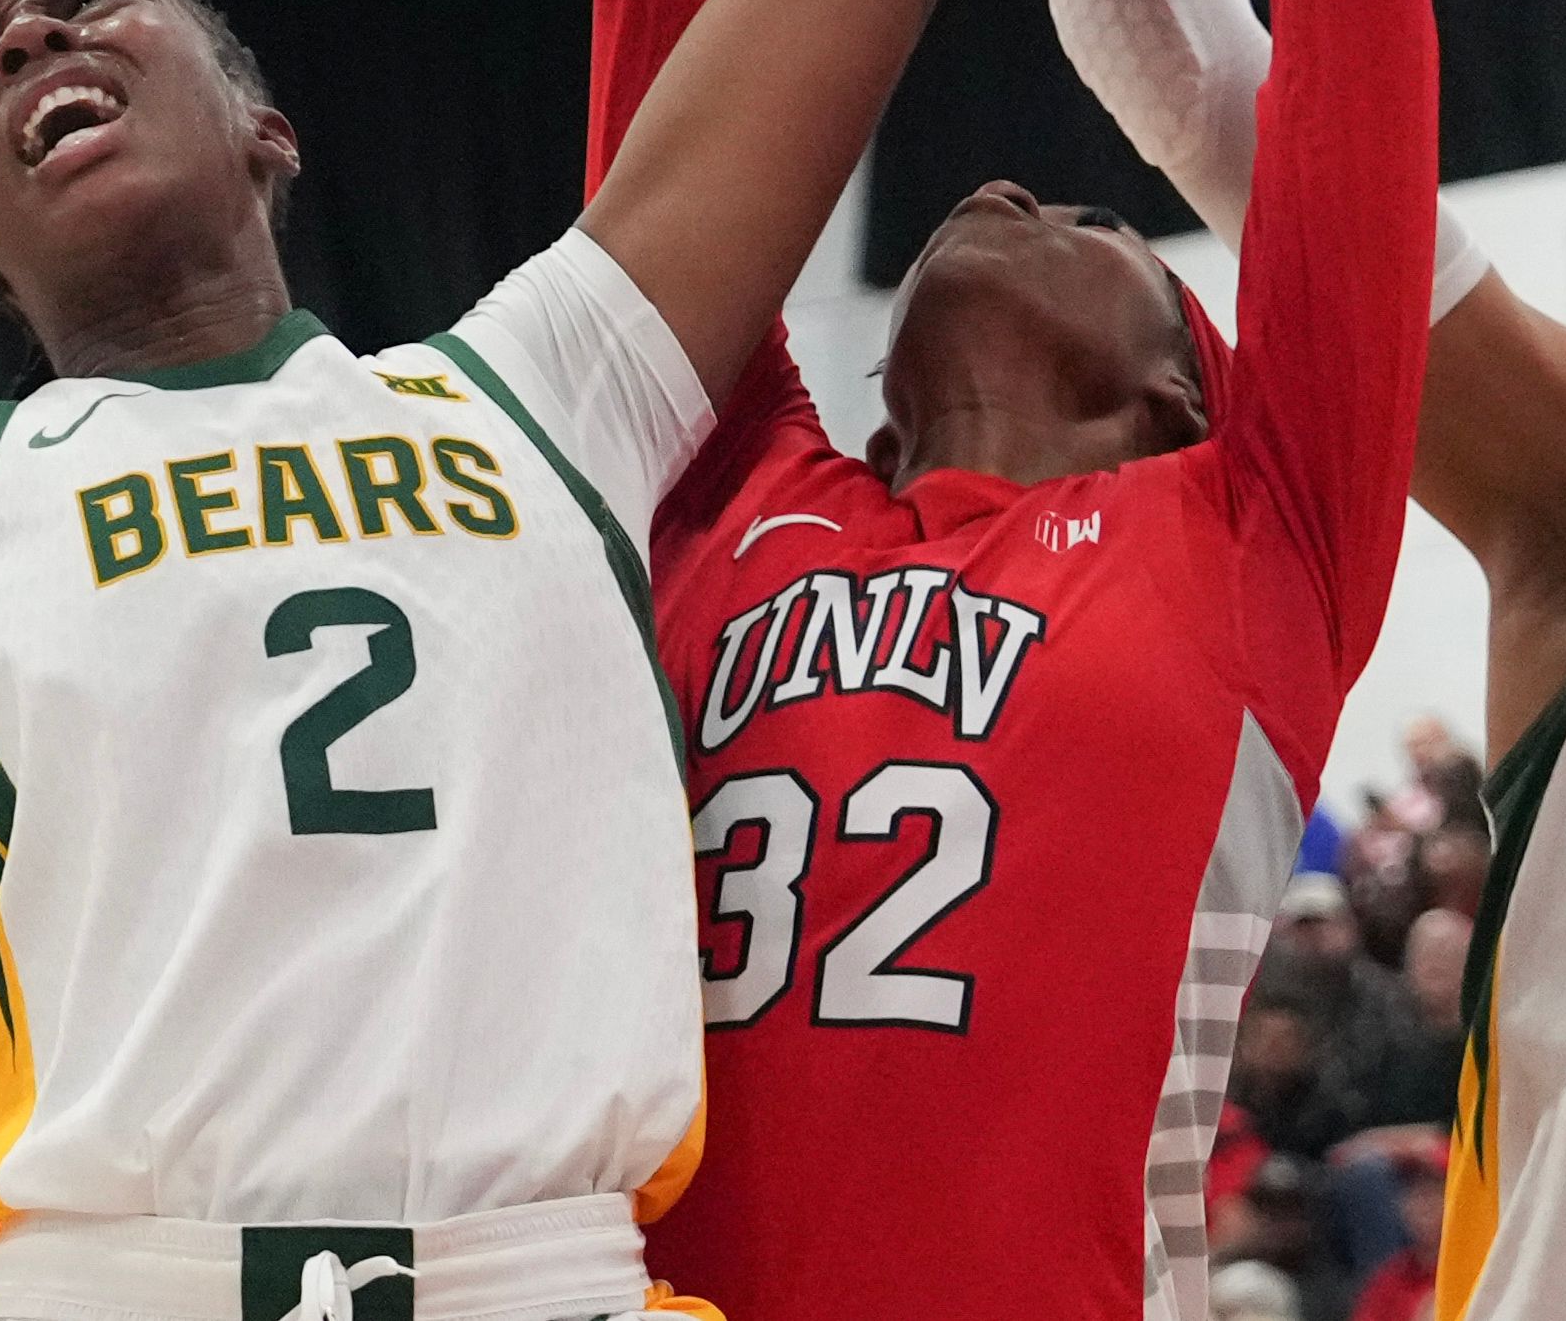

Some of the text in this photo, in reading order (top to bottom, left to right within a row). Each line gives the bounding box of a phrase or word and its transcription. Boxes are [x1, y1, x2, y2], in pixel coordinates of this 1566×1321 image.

[75, 434, 521, 588] BEARS
[264, 586, 437, 837] 2
[695, 564, 1046, 755] UNLV
[691, 760, 1000, 1035] 32
